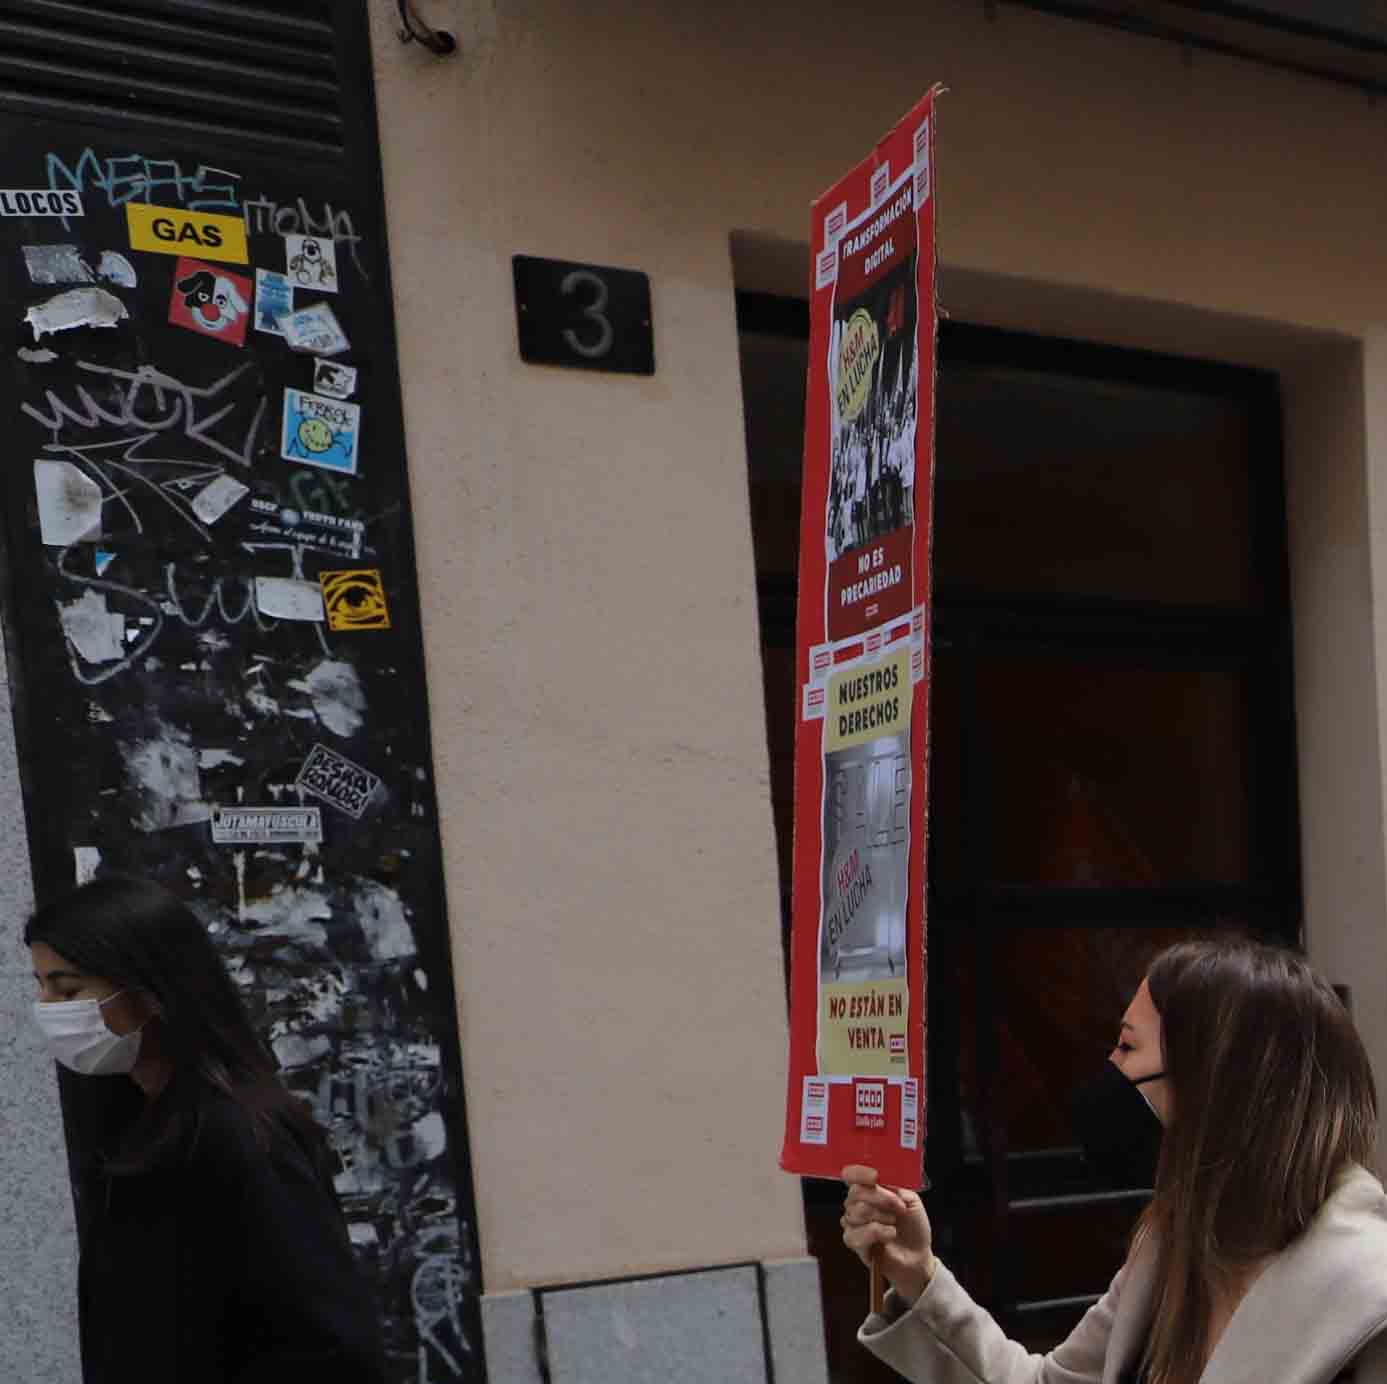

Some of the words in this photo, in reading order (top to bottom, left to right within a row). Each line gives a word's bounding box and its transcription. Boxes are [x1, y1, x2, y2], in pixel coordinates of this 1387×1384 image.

[1, 191, 79, 216] LOCOS
[842, 186, 914, 260] TRANSFORMACIÓN
[152, 218, 223, 248] GAS
[864, 237, 895, 275] DIGITAL
[561, 270, 614, 358] 3
[842, 325, 865, 373] H&M
[850, 334, 878, 393] LUCHA
[858, 556, 871, 576] NO
[872, 546, 885, 568] ES
[840, 565, 901, 607] PRECARIEDAD
[838, 663, 899, 705] NUESTROS
[838, 697, 899, 738] DERECHOS
[842, 863, 873, 924] LUCHA
[829, 996, 846, 1020] NO
[849, 989, 885, 1020] ESTÁN
[888, 993, 903, 1018] EN
[847, 1026, 886, 1049] VENTA
[857, 1089, 883, 1108] CCOO
